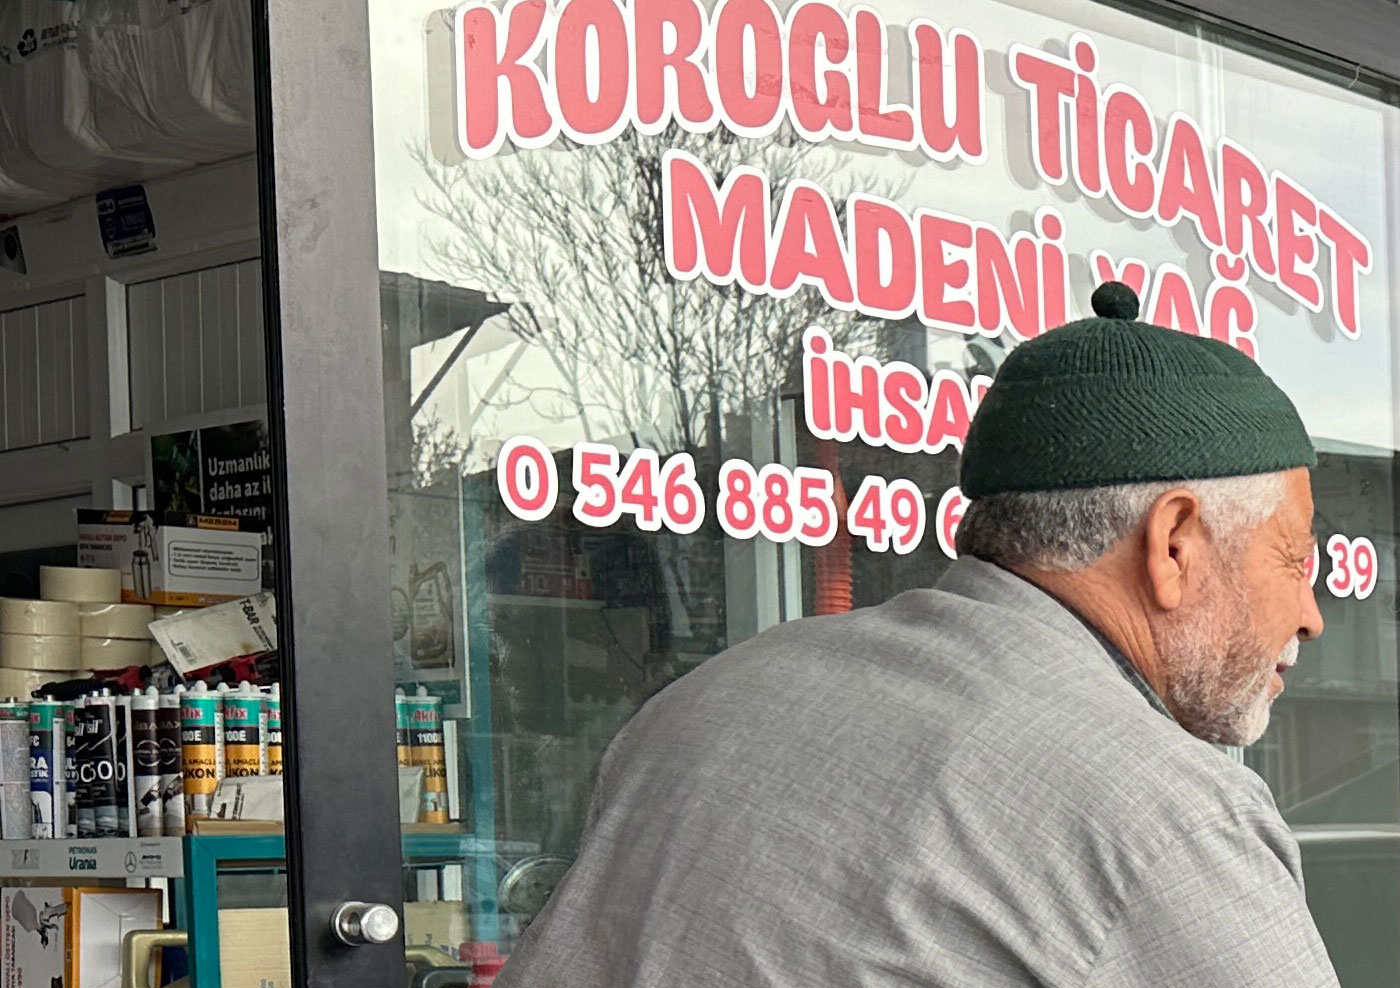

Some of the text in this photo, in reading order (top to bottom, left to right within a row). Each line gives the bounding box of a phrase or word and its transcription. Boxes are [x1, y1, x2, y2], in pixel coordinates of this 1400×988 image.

[661, 149, 1069, 342] MADENİ
[1010, 32, 1373, 340] TİCARET
[803, 326, 989, 454] İHSA
[208, 450, 270, 476] Uzmanlık
[210, 480, 242, 501] daha
[244, 482, 260, 497] az
[572, 442, 705, 534] 546
[716, 459, 838, 546] 885
[847, 475, 926, 554] 49
[1326, 534, 1378, 600] 39
[69, 857, 97, 870] Urania
